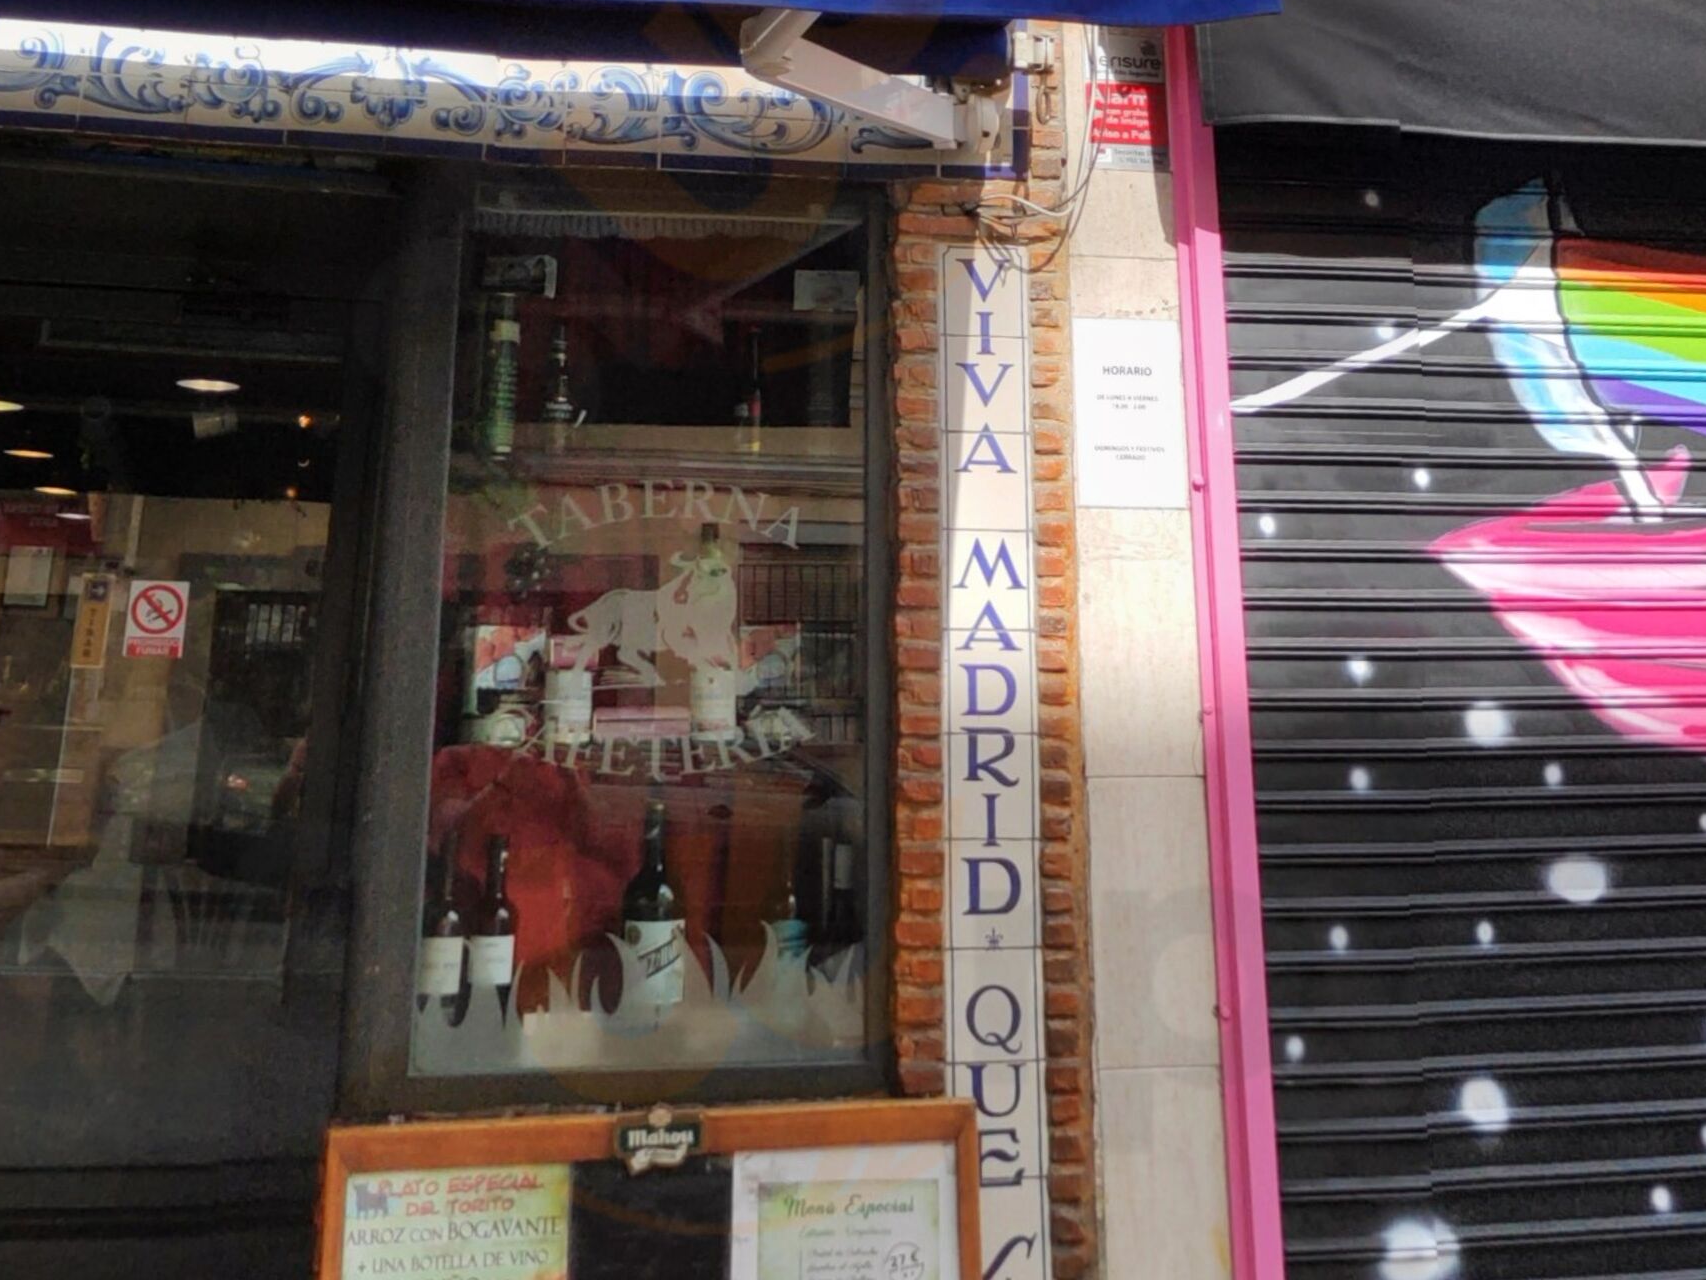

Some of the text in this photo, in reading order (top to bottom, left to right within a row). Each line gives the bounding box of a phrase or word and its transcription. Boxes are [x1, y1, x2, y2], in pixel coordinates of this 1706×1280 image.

[954, 257, 1018, 475] VIVA
[1102, 365, 1152, 377] HORARIO
[506, 478, 803, 550] TABERNA
[951, 537, 1028, 917] MADRID
[964, 984, 1027, 1189] QUE
[628, 1128, 695, 1147] Mahou
[378, 1173, 545, 1198] PLATO ESPECIAL
[446, 1196, 516, 1214] TORITO
[346, 1227, 406, 1248] ARROZ
[446, 1216, 562, 1242] BOGAVANTE
[371, 1256, 406, 1275] UNA
[409, 1253, 478, 1272] BOTELLA
[483, 1251, 505, 1268] DE
[508, 1249, 550, 1267] VINO
